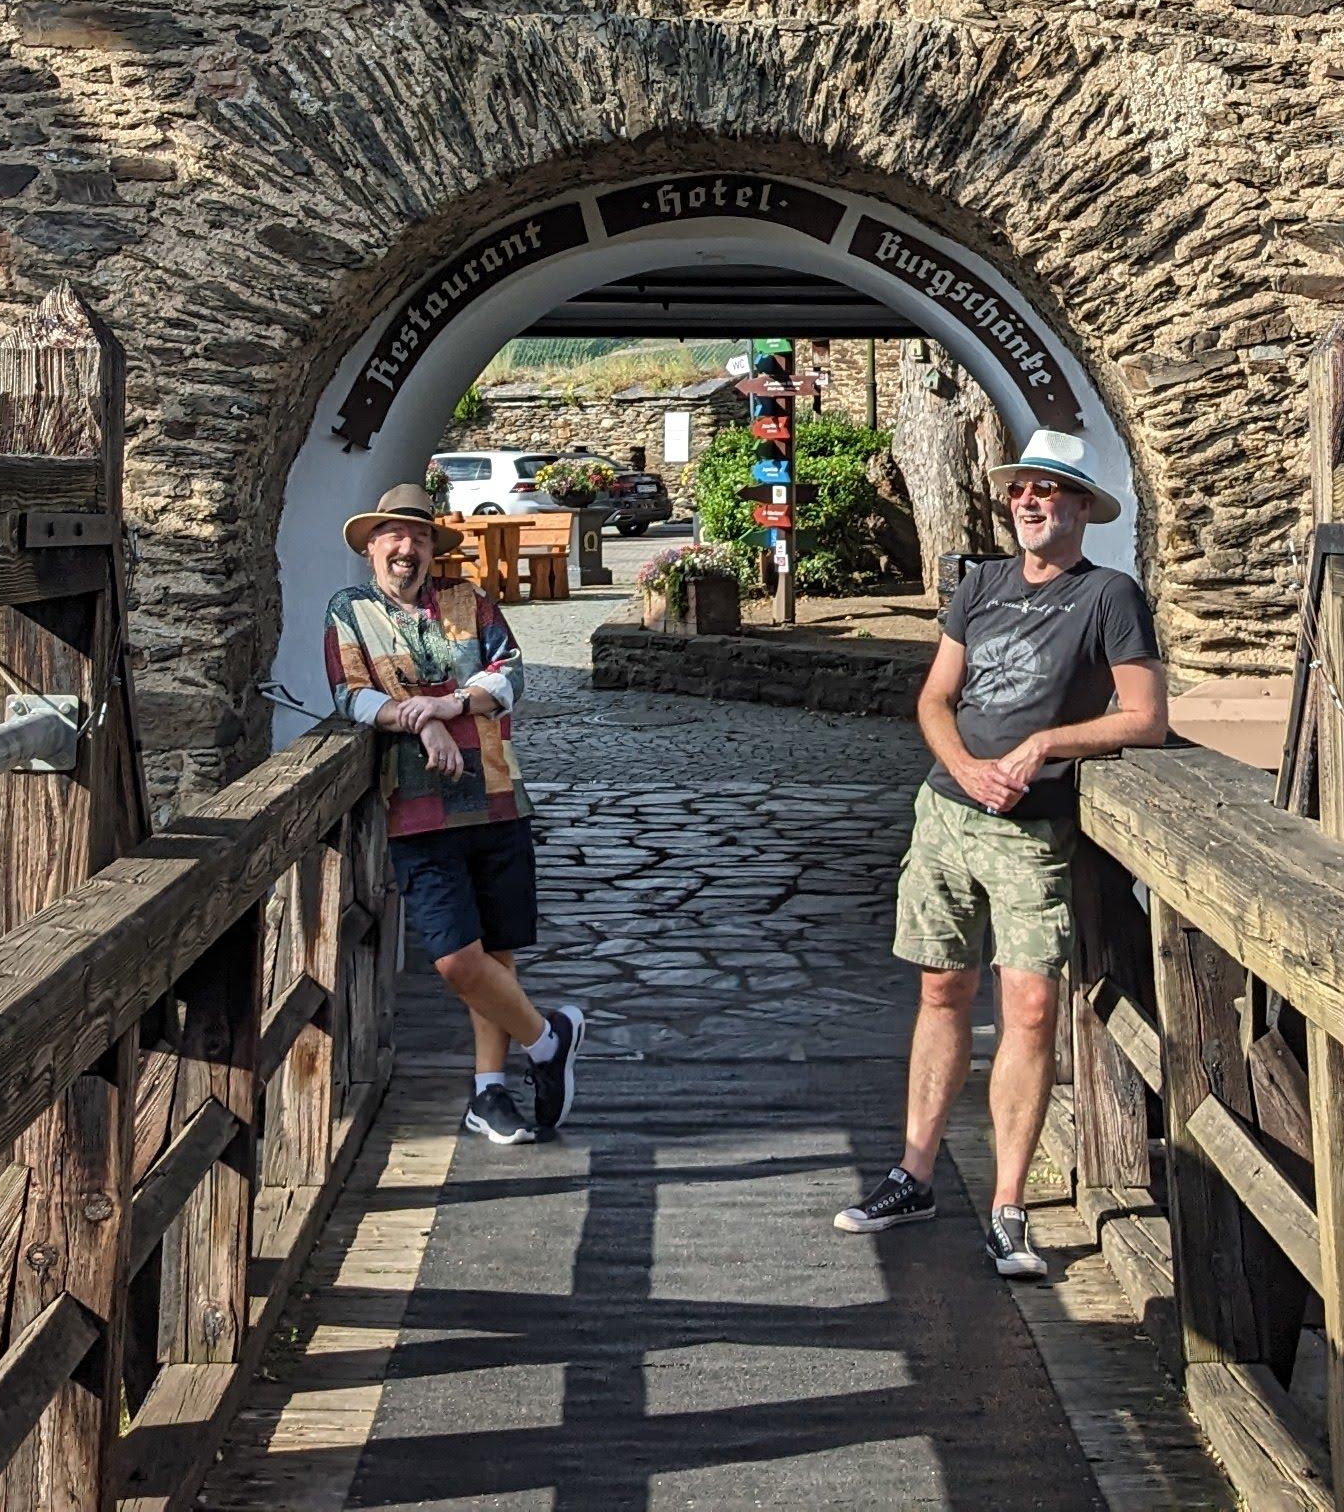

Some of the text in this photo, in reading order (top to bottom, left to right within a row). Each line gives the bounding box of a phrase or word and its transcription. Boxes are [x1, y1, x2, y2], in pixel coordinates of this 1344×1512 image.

[656, 178, 772, 217] Hotel
[365, 219, 542, 392] Restaurant
[874, 231, 1052, 388] Burgschänke
[731, 358, 745, 371] WC
